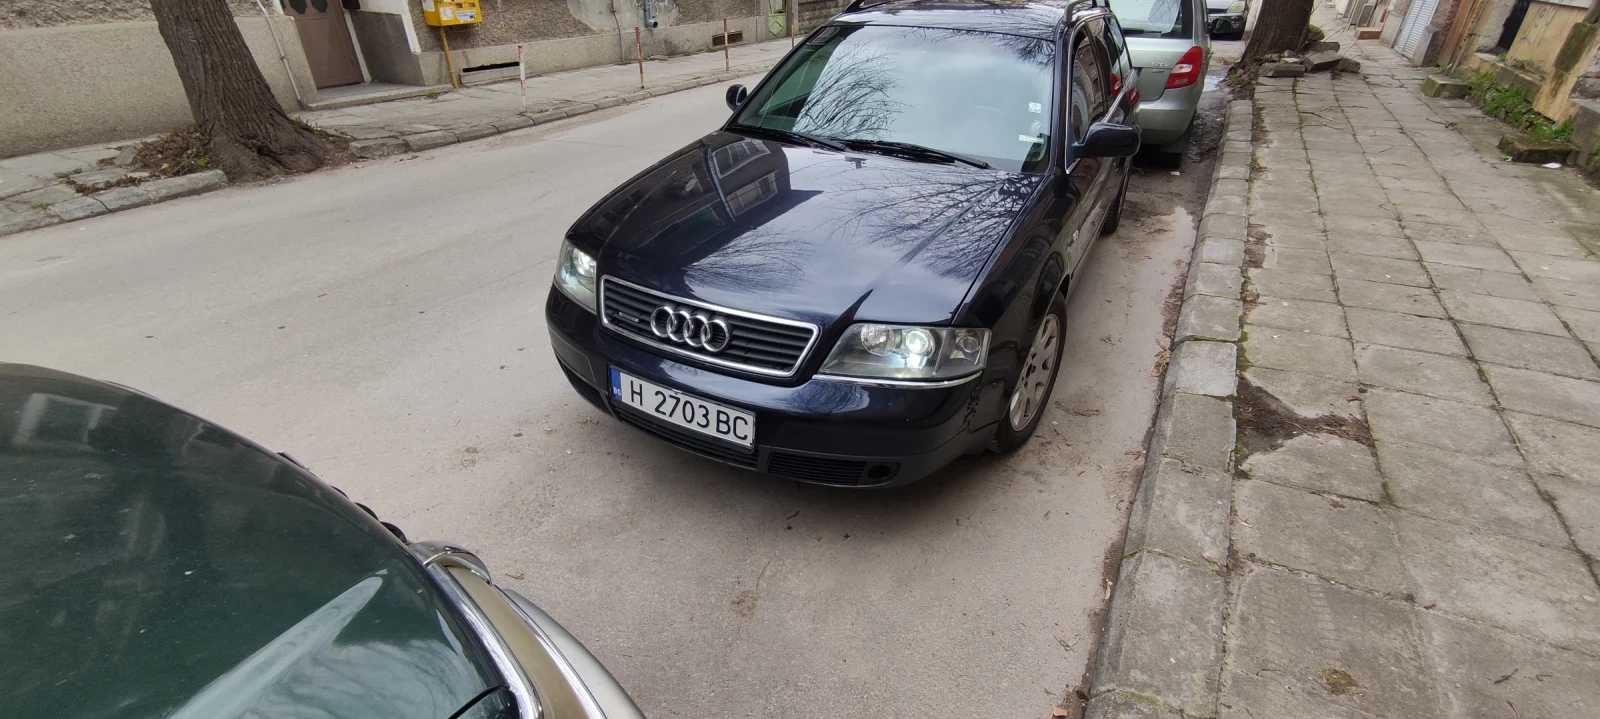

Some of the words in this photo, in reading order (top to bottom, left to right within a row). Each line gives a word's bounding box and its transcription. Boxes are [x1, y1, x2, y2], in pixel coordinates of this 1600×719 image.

[613, 386, 622, 396] BG
[630, 380, 643, 406] H
[654, 390, 710, 428] 2703
[716, 409, 748, 440] BC
